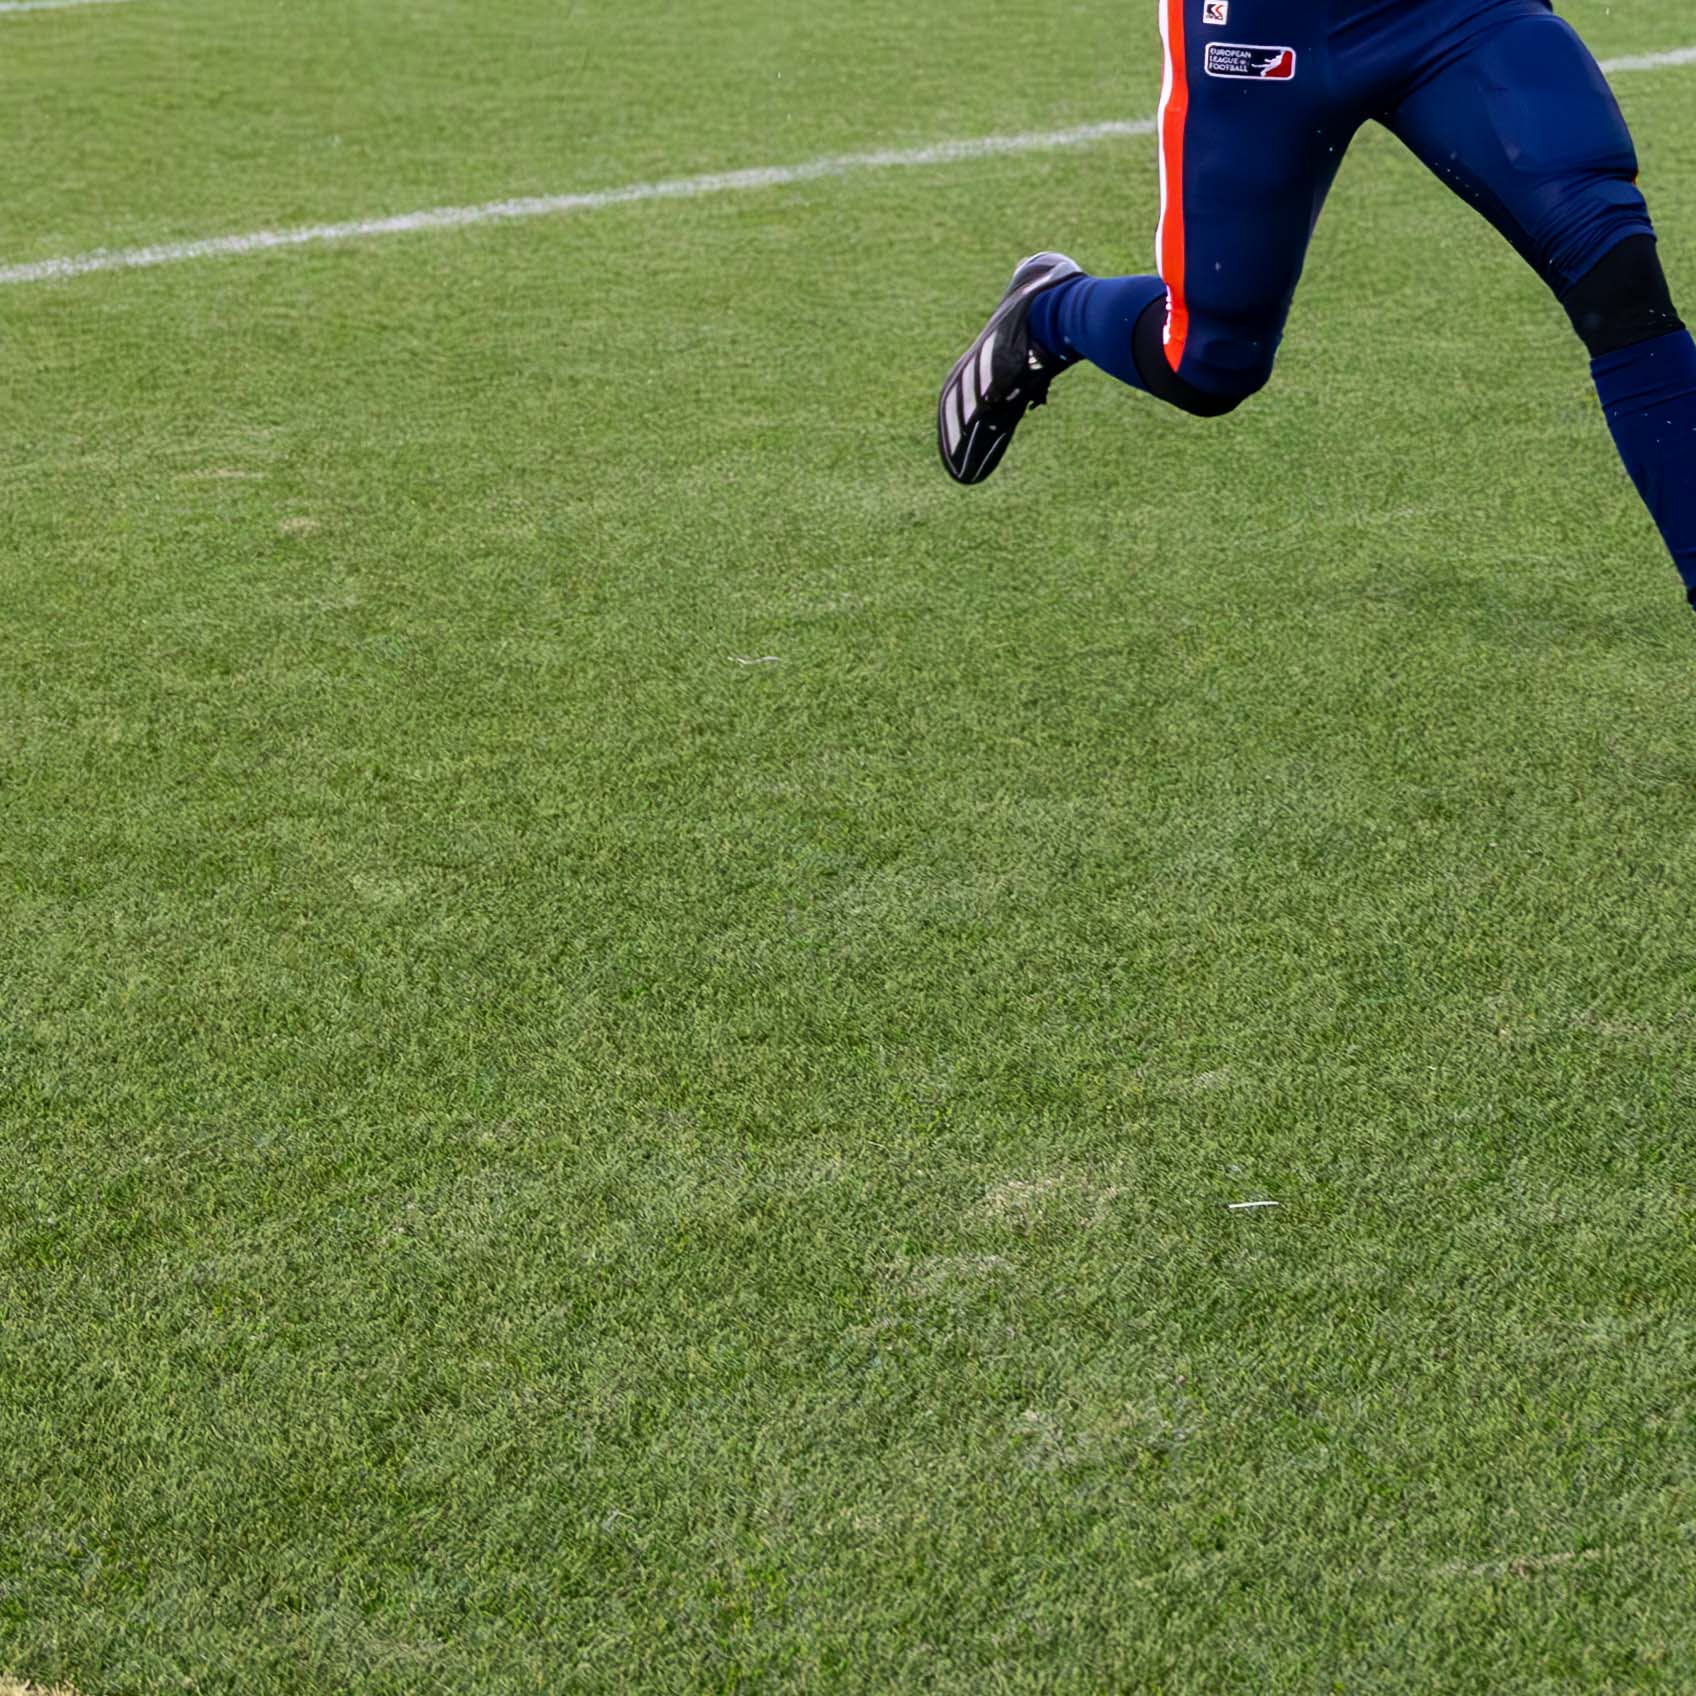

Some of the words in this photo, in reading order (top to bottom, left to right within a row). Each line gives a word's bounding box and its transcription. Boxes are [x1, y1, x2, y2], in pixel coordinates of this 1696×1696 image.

[1210, 48, 1251, 58] EUROPEAN
[1209, 56, 1238, 64] LEAGUE
[1209, 63, 1248, 72] FOOTBALL
